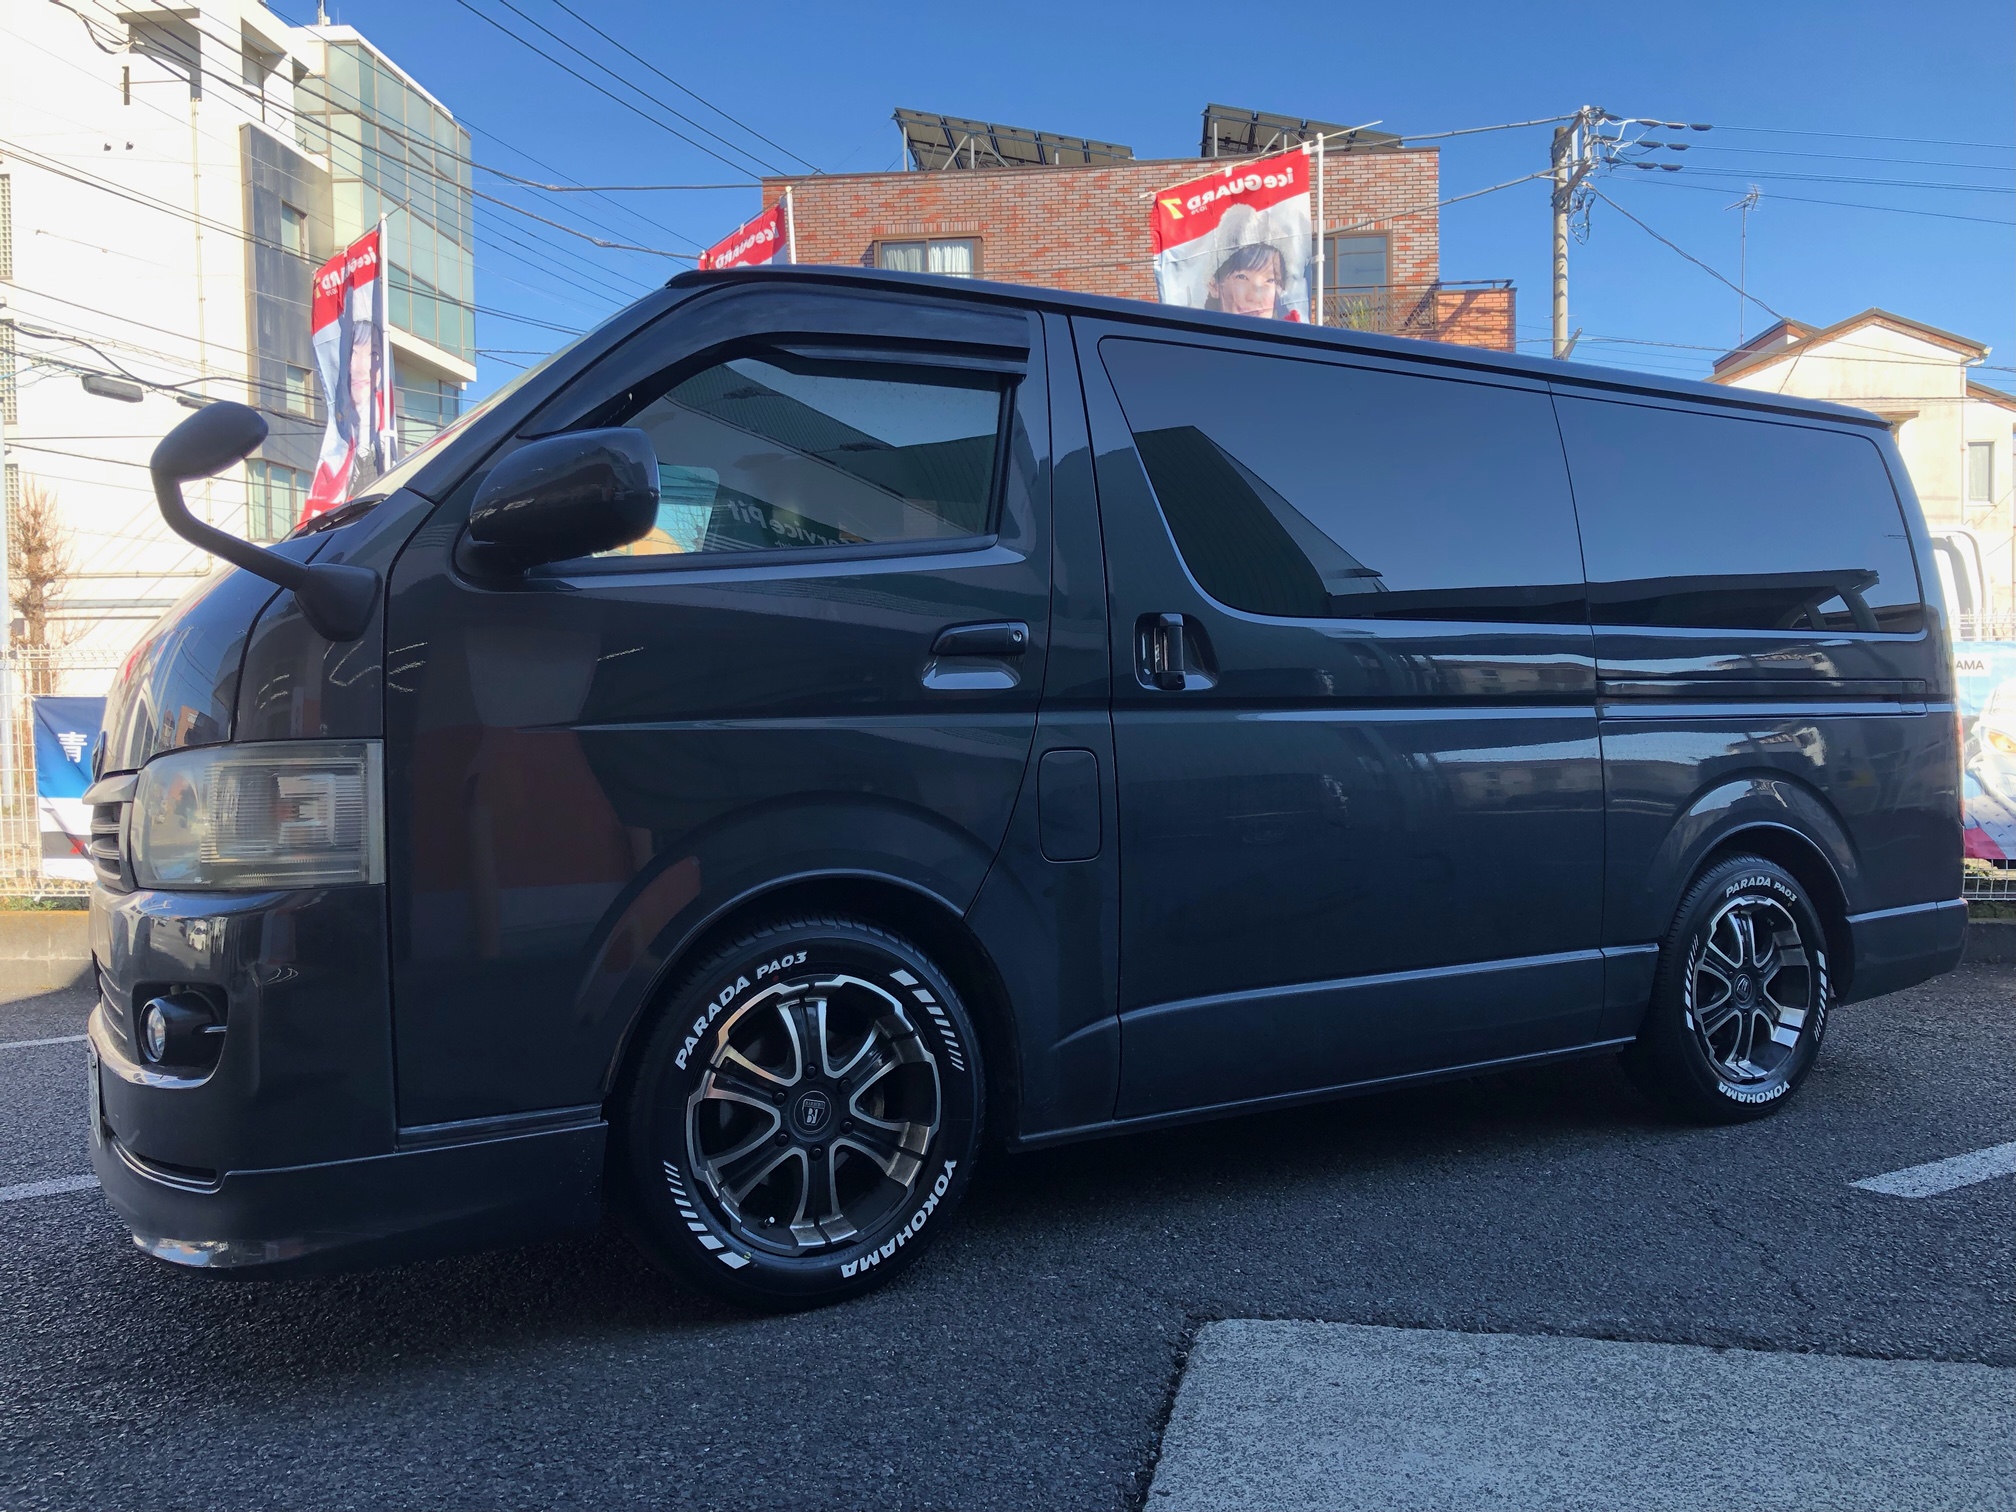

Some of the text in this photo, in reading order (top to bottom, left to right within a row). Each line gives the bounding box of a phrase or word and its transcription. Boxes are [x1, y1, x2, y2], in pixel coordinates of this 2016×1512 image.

[57, 731, 88, 764] 青
[1726, 876, 1771, 898] PARADA
[675, 976, 751, 1071] PARADA
[1718, 1081, 1791, 1104] YOKOHAMA
[841, 1160, 957, 1278] YOKOHAMA
